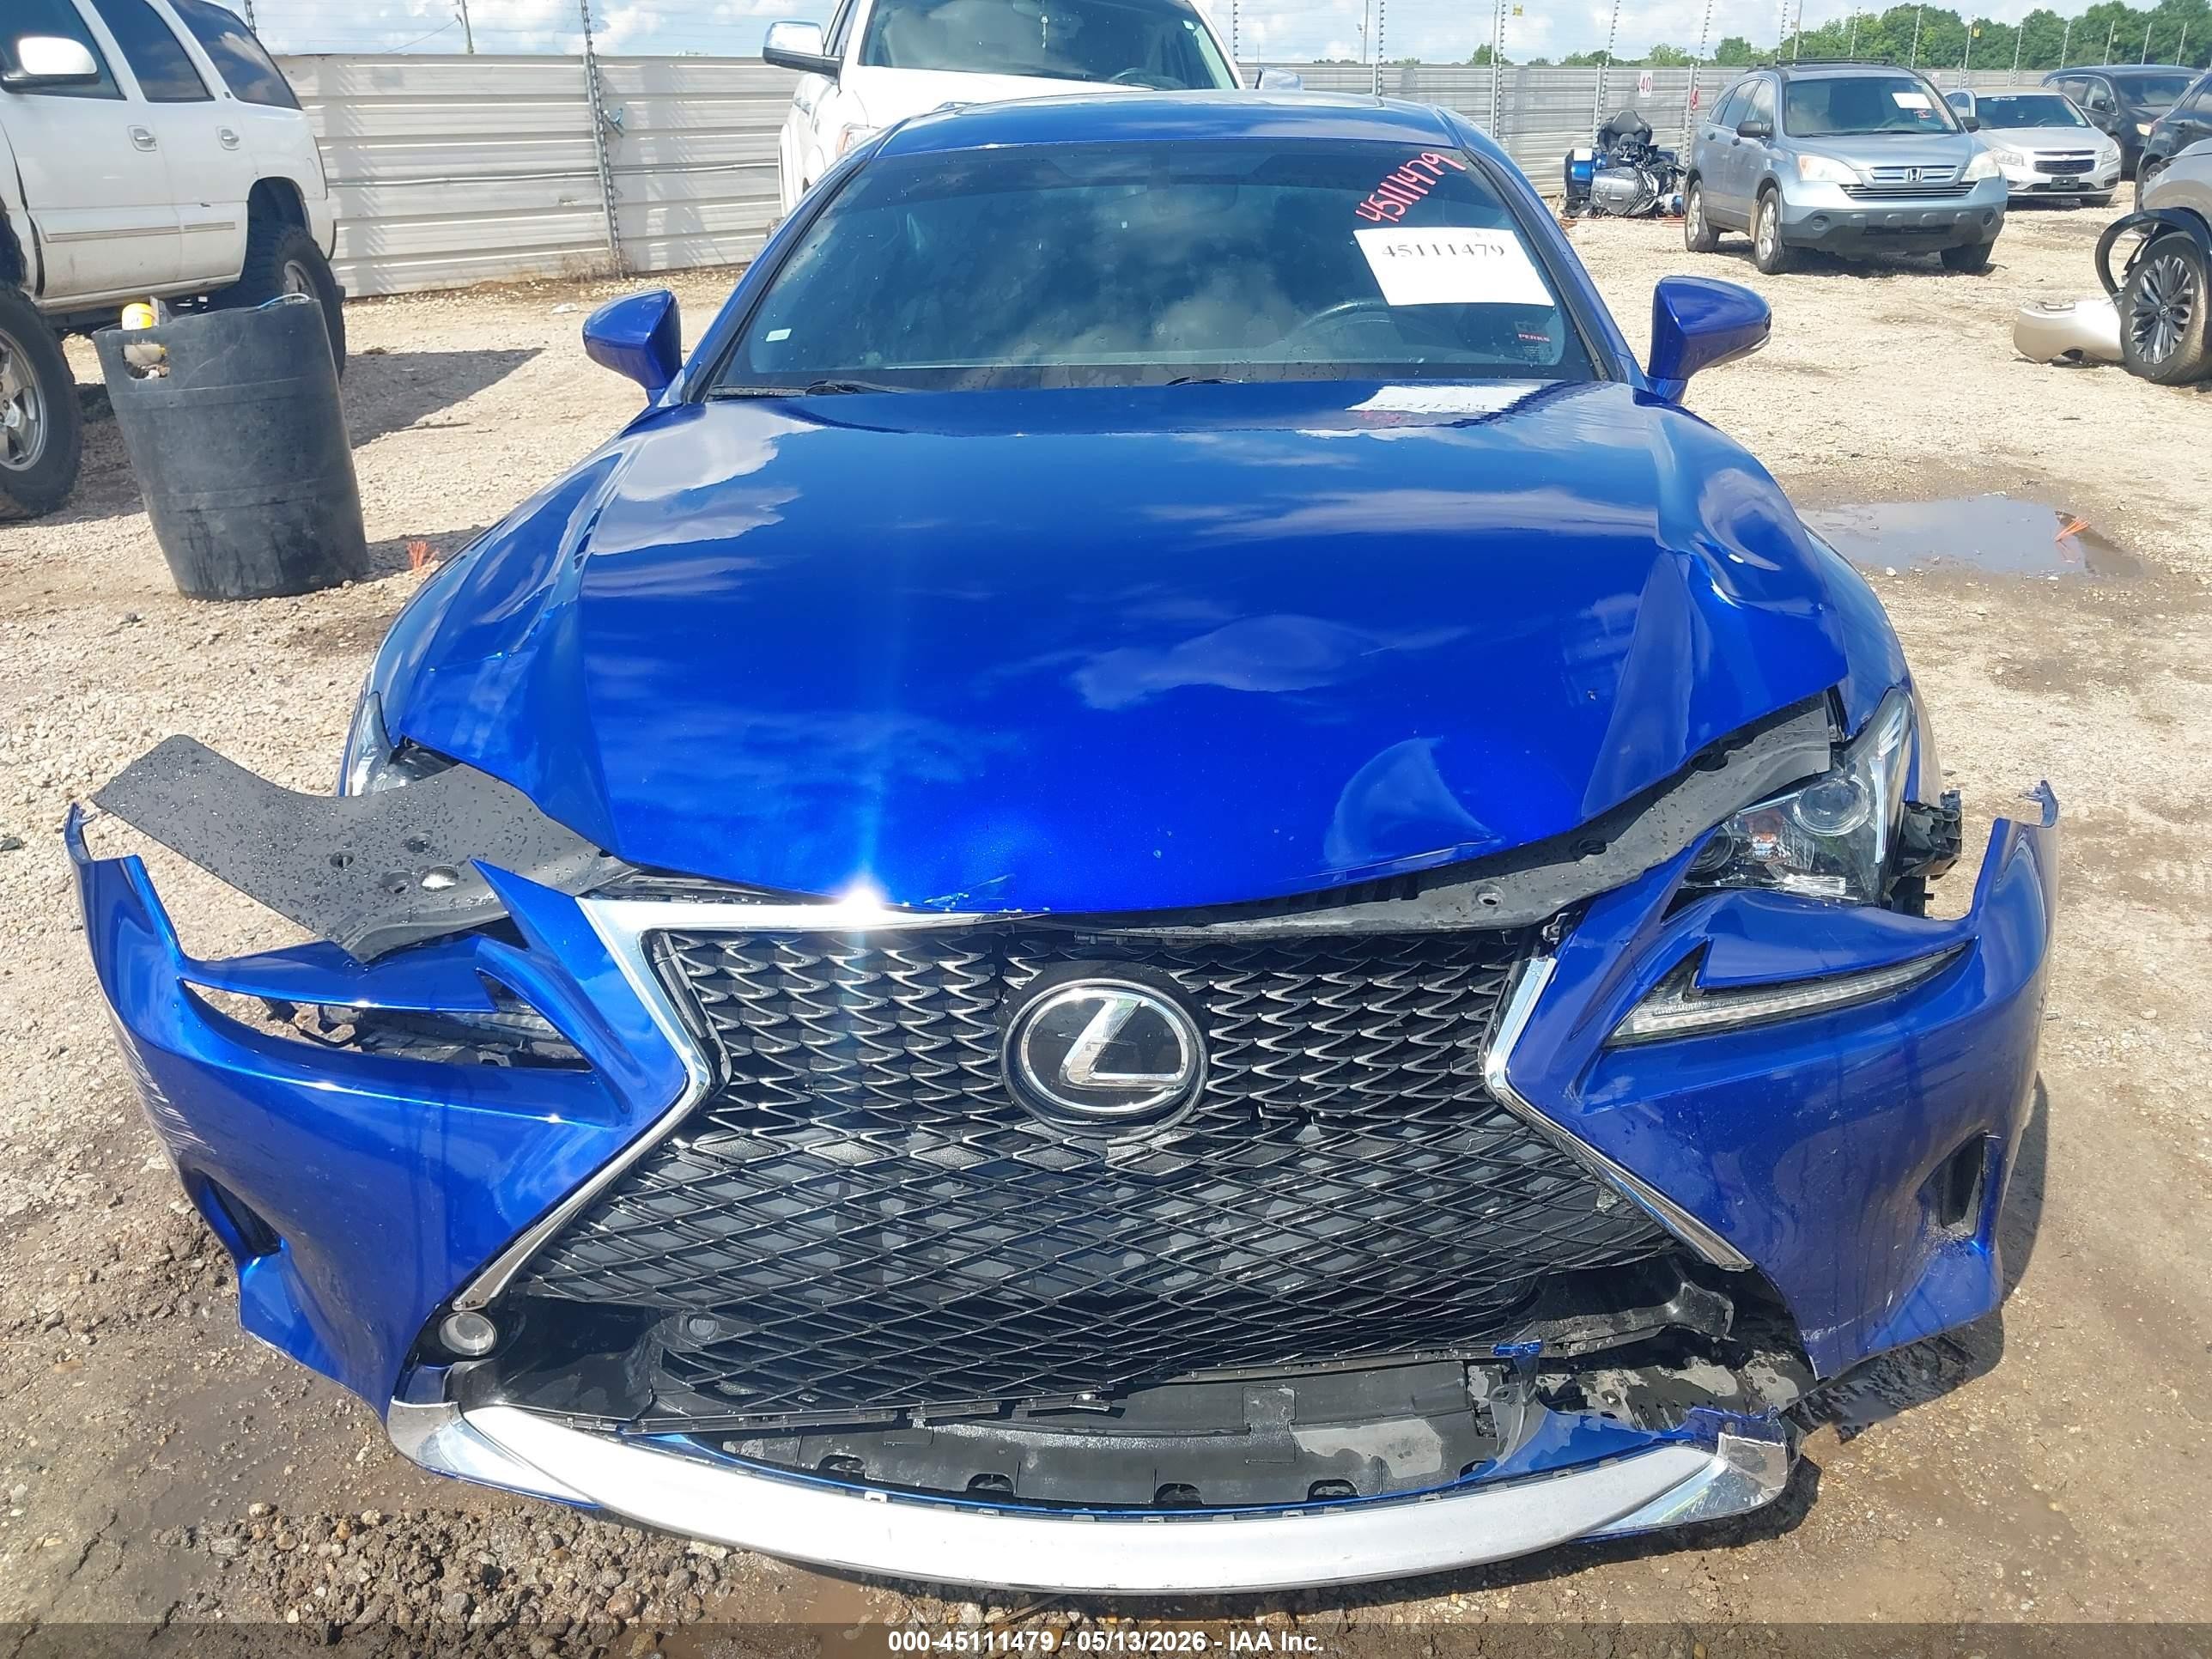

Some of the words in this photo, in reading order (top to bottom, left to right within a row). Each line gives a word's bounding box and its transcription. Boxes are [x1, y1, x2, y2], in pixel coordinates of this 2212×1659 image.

[1640, 76, 1652, 93] 40
[1355, 152, 1467, 222] 45111479
[1382, 243, 1505, 258] 45111479
